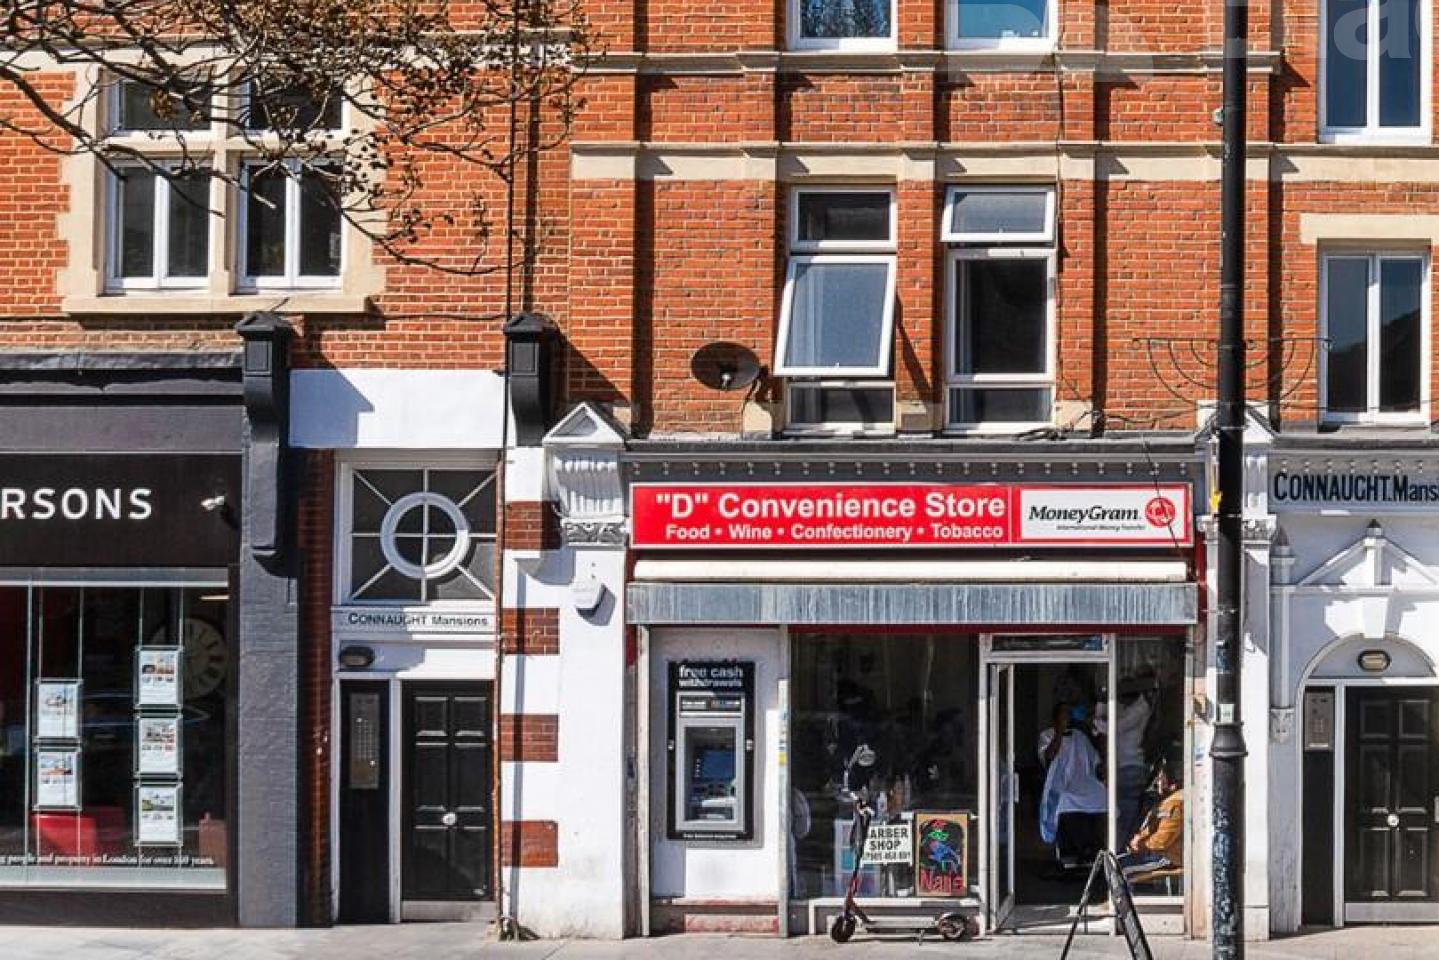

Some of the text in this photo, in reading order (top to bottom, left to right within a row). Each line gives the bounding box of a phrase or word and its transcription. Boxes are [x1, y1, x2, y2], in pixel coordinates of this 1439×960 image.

[656, 492, 1005, 519] "D" Convenience Store
[1028, 505, 1139, 523] MoneyGram
[666, 523, 1003, 542] Food Wine Confectionery Tobacco
[431, 616, 489, 626] Mansions
[870, 827, 909, 840] ARBER
[869, 840, 901, 851] SHOP
